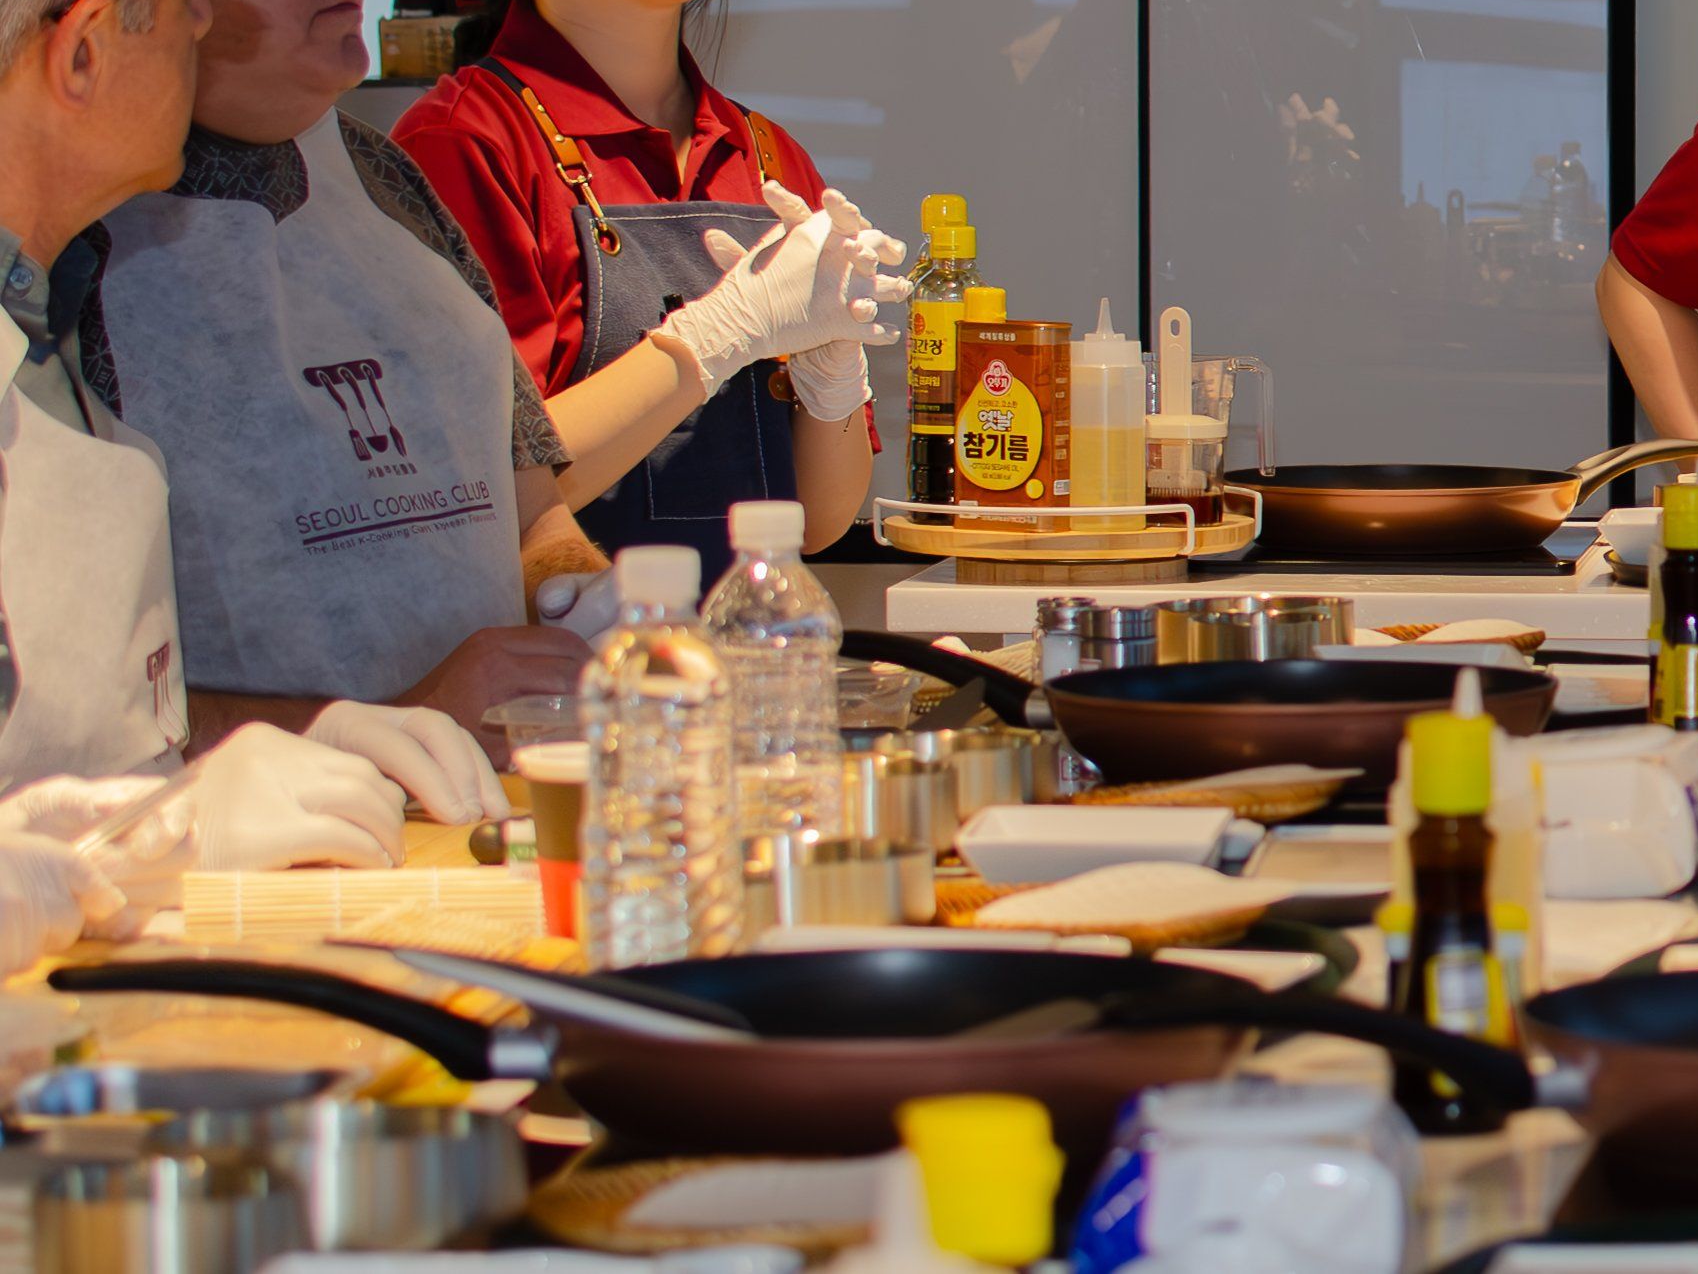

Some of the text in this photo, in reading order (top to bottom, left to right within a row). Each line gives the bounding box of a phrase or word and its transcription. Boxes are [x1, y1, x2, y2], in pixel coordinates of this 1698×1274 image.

[978, 410, 1014, 431] 옛날
[963, 432, 1029, 461] 참기름
[295, 503, 370, 534] SEOUL
[373, 490, 448, 518] COOKING
[451, 481, 490, 503] CLUB
